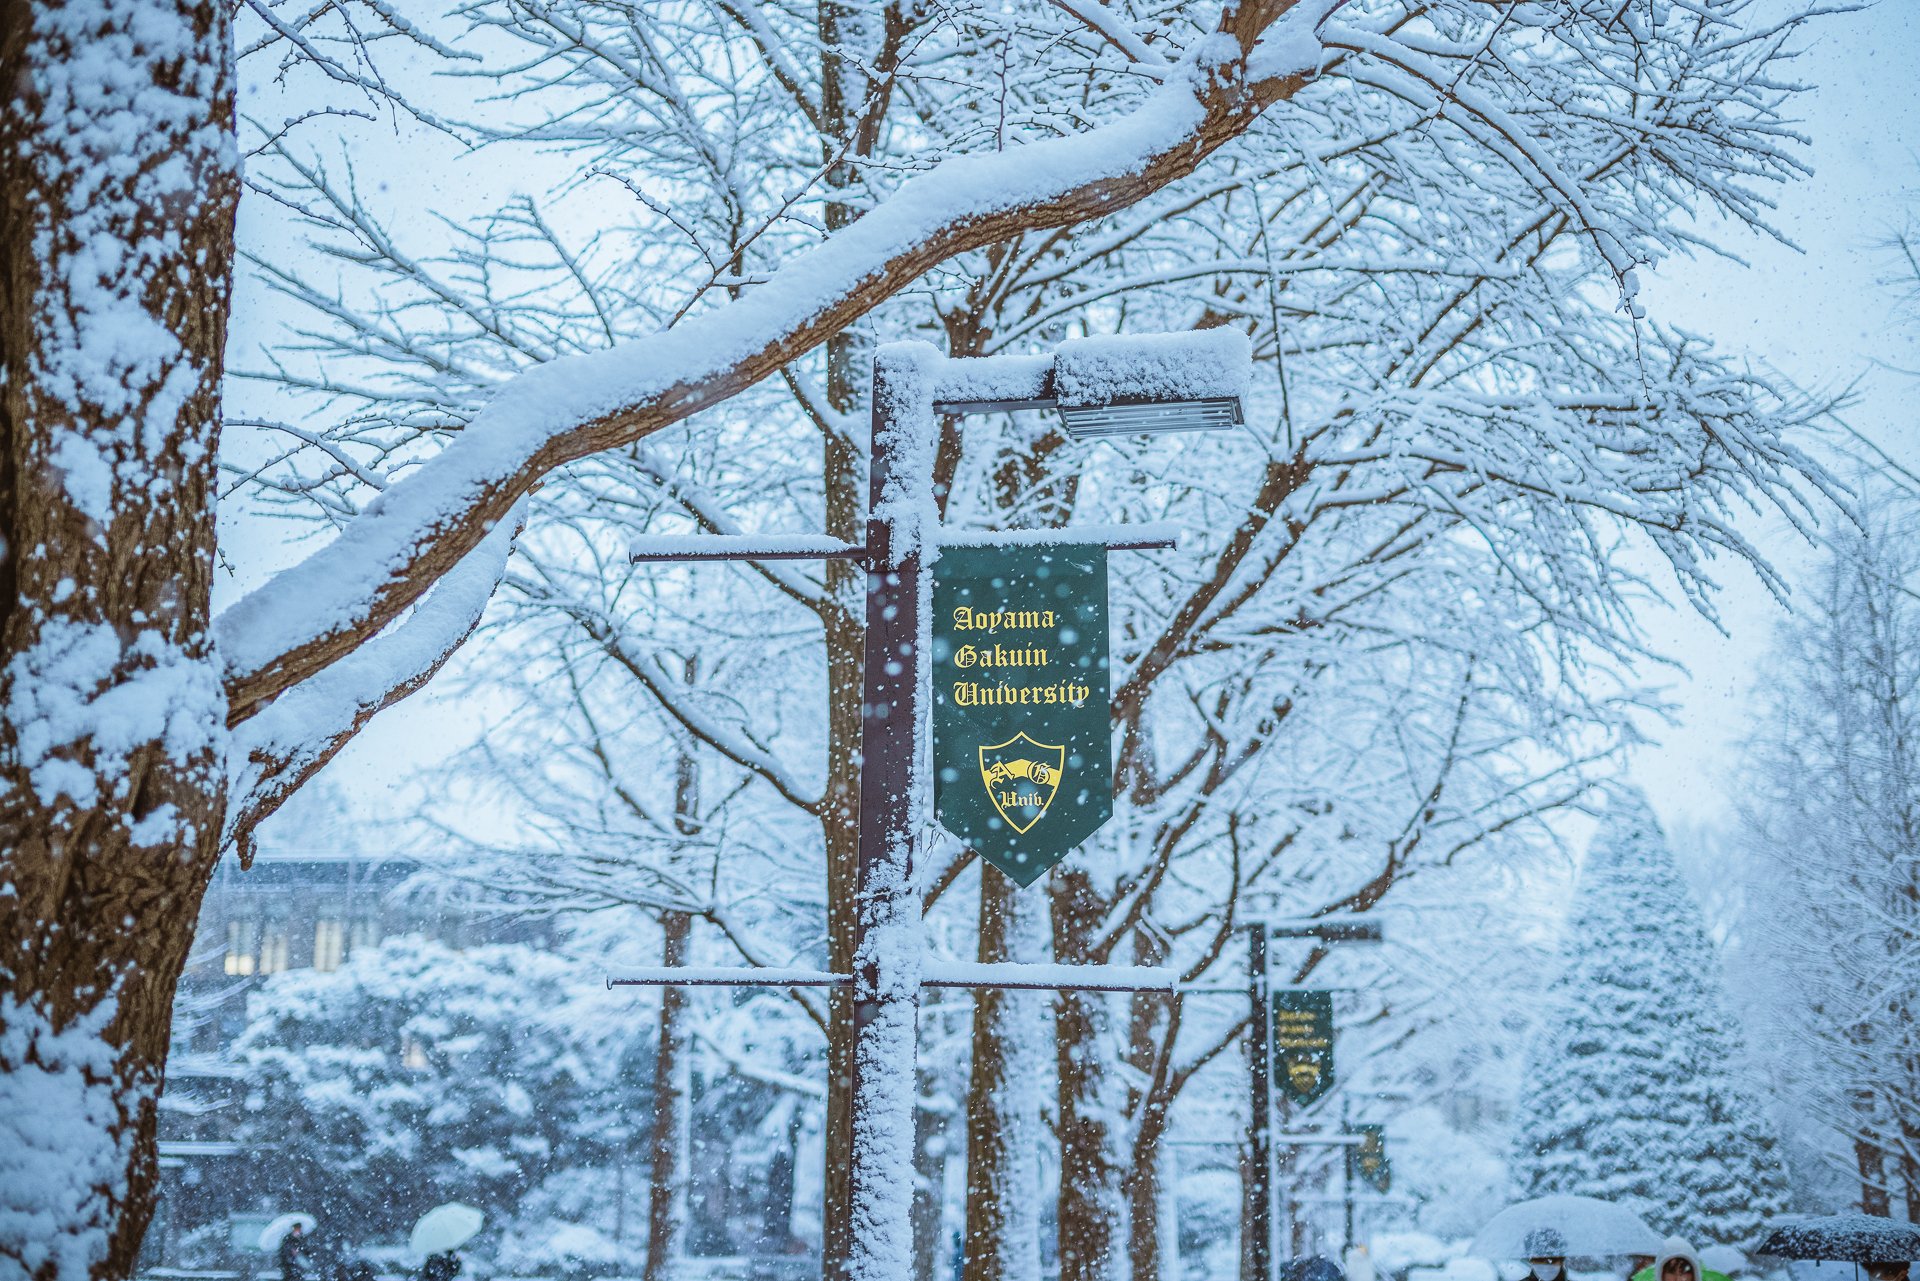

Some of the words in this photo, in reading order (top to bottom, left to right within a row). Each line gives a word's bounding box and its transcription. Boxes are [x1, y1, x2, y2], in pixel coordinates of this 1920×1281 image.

[953, 606, 1055, 635] Aoyama
[953, 642, 1048, 669] Gakuin
[953, 679, 1090, 709] University
[989, 760, 1015, 789] A
[1027, 760, 1051, 785] G
